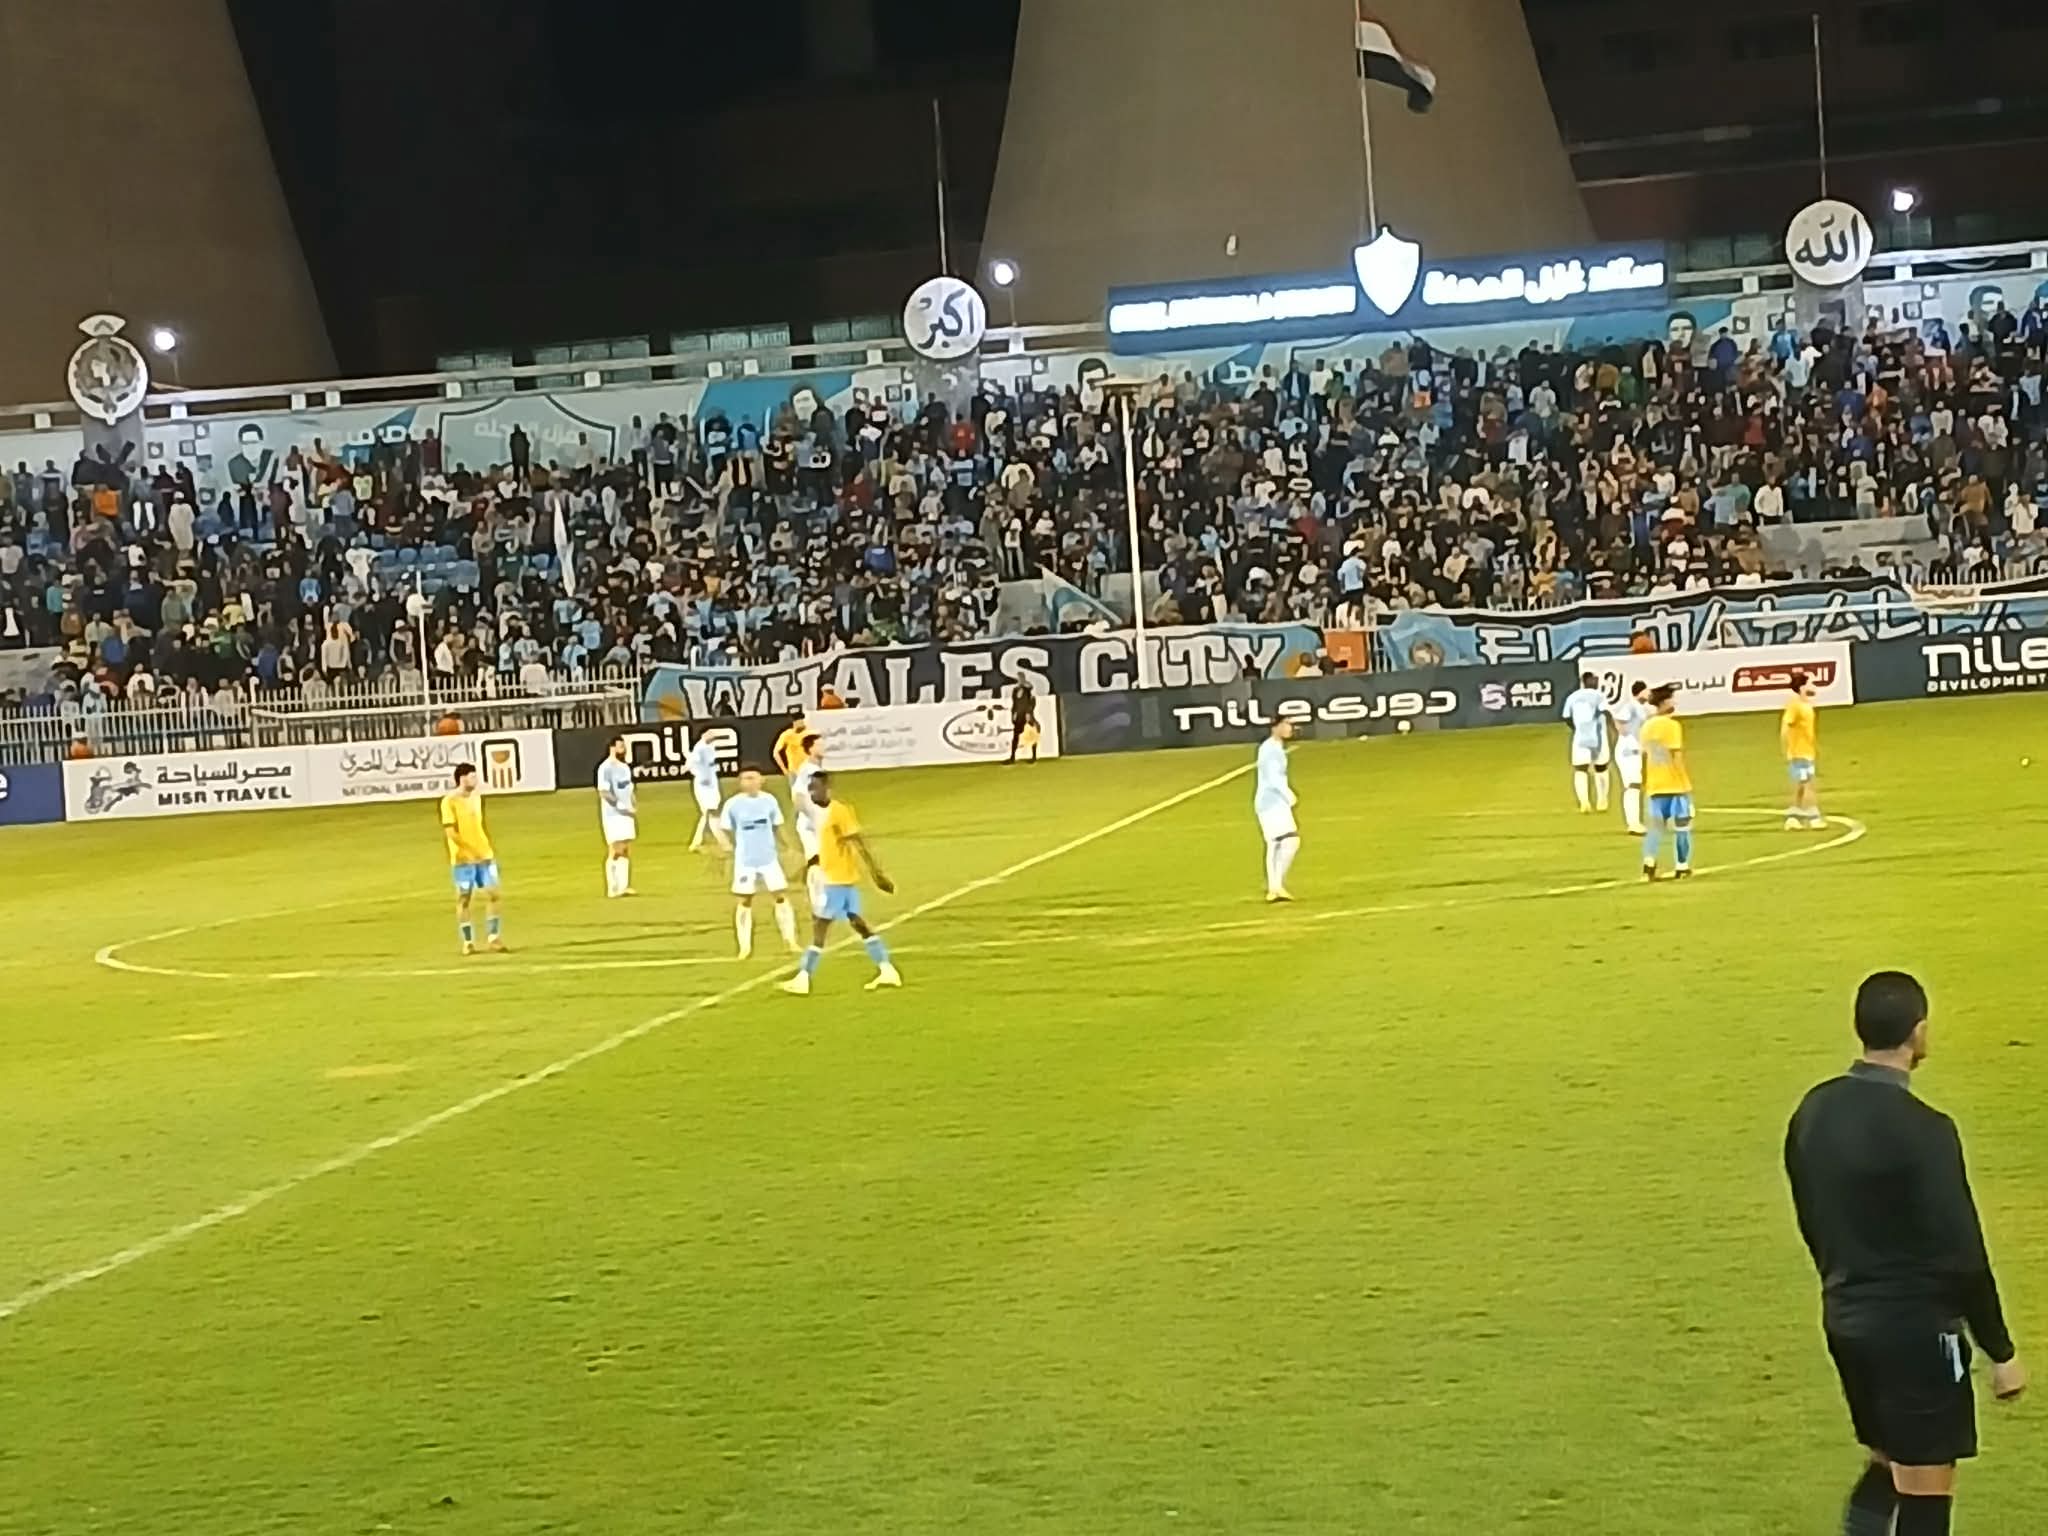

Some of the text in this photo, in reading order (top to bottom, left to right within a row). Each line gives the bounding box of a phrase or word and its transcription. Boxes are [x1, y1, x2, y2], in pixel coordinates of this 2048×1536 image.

[1795, 213, 1860, 267] الله
[682, 635, 1284, 719] WHALES CITY
[157, 760, 292, 787] مصر للسياحة
[157, 785, 293, 806] MISR TRAVEL
